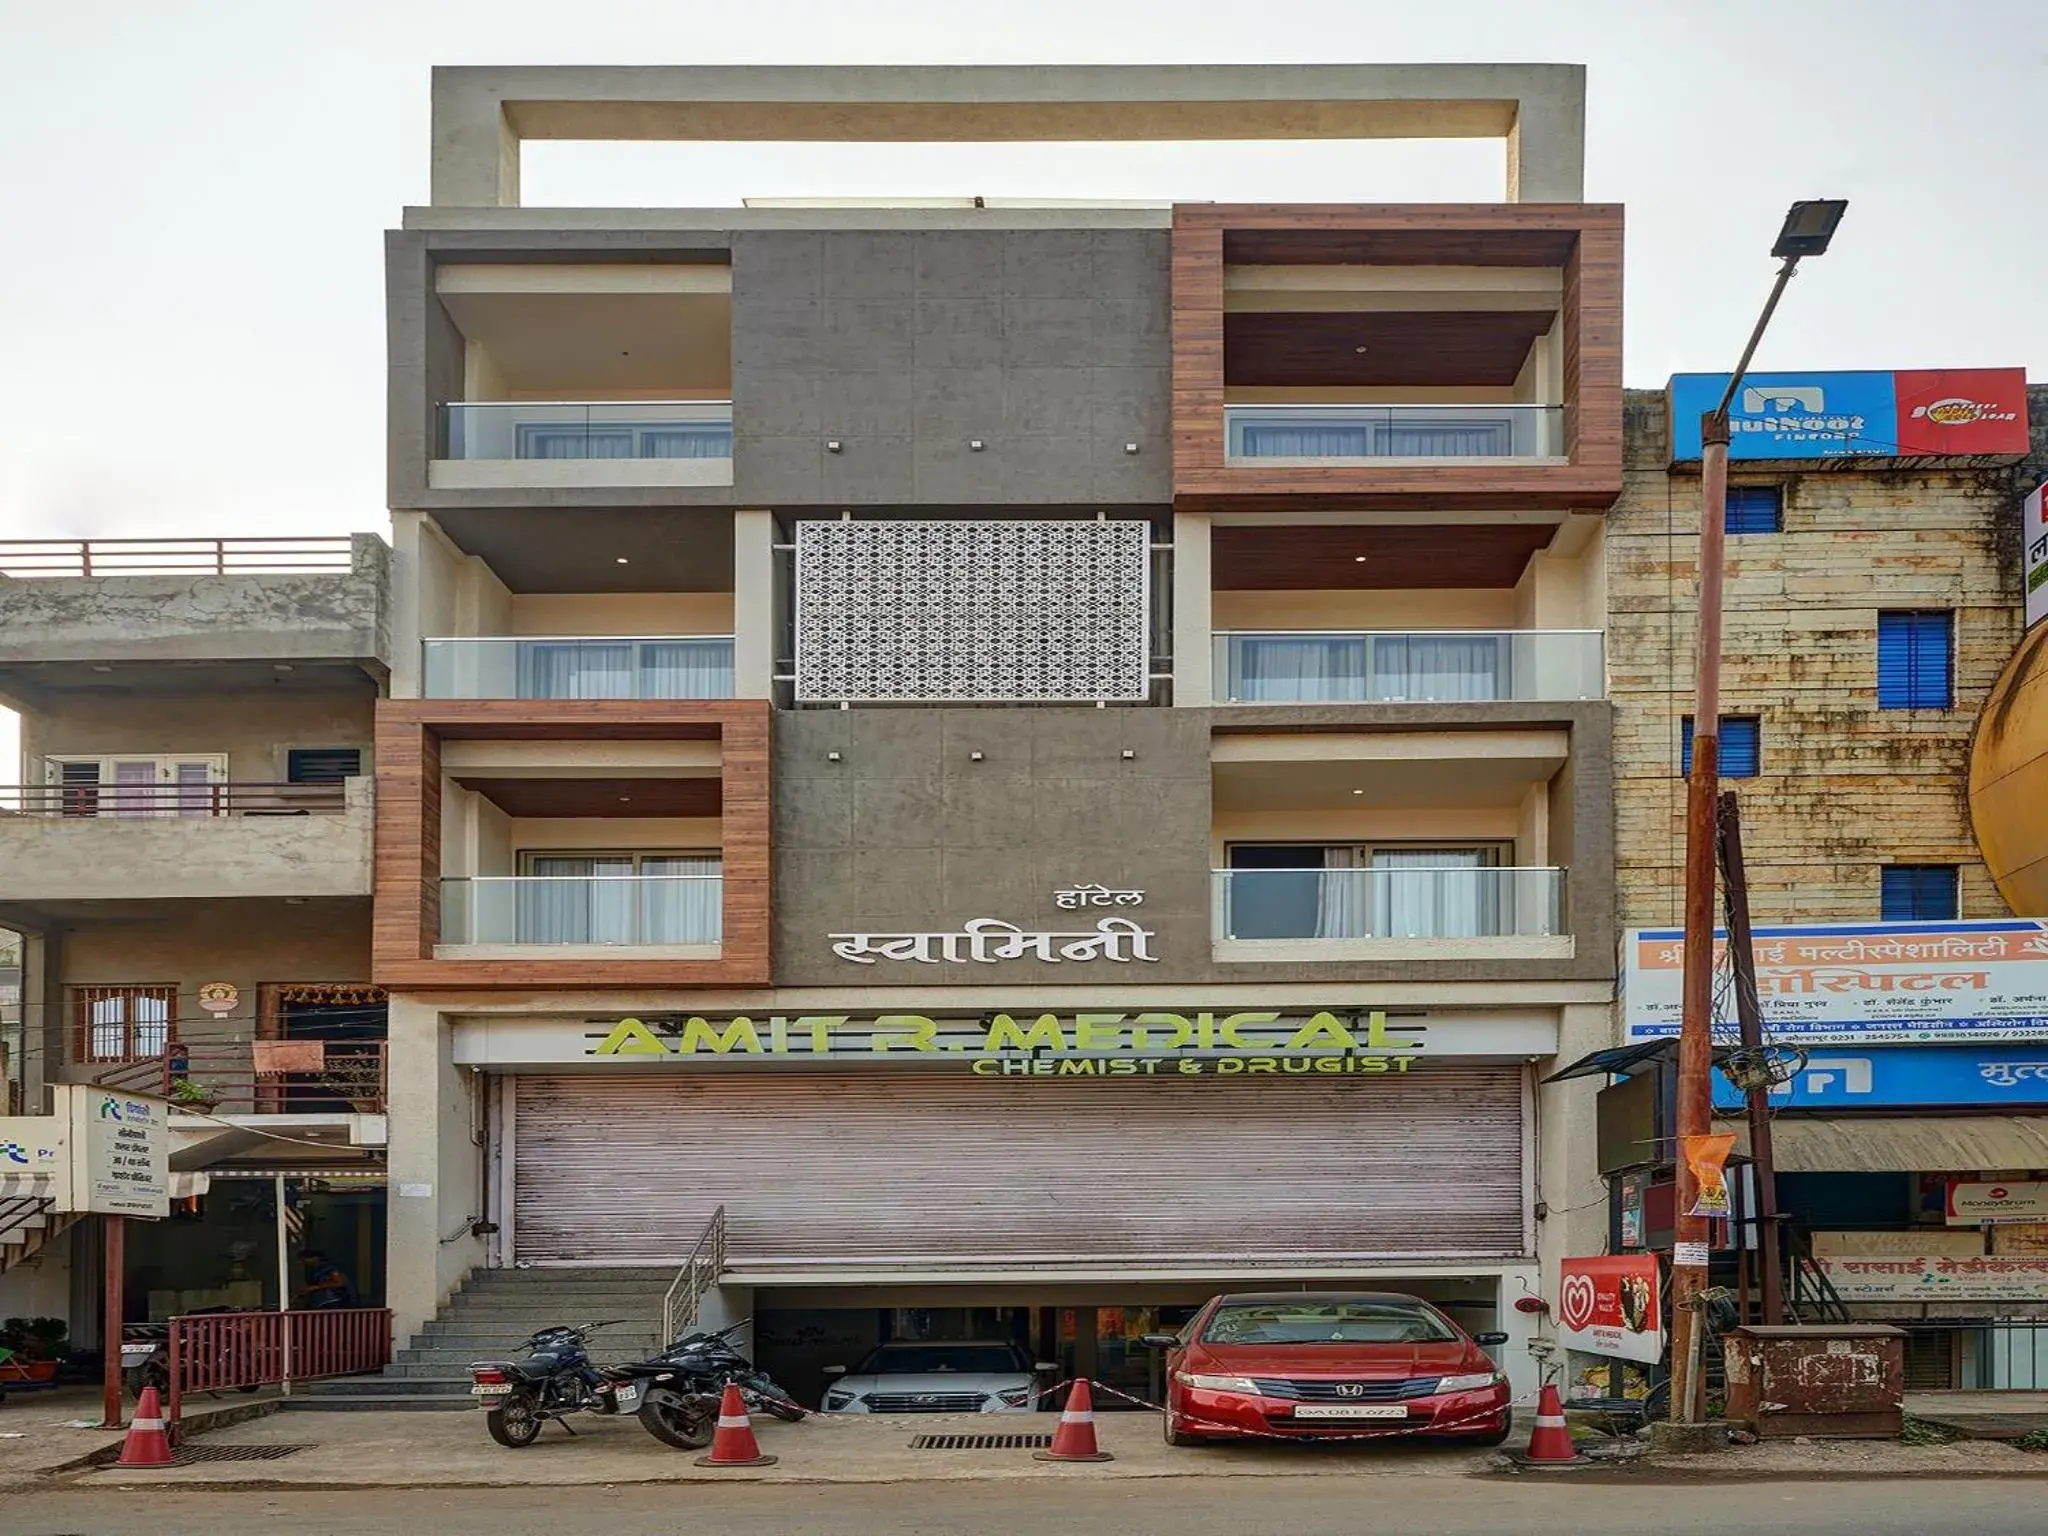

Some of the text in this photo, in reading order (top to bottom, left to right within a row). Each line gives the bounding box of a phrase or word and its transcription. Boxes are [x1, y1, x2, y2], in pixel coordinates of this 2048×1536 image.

[1054, 884, 1146, 909] हॉटेल
[827, 917, 1160, 964] स्वामिनी
[1797, 936, 2008, 961] मल्टीस्पेशालिटी
[595, 1015, 850, 1054] AMIT
[984, 1010, 1424, 1051] MEDICAL
[972, 1055, 1416, 1076] CHEMIST & DRUGIST
